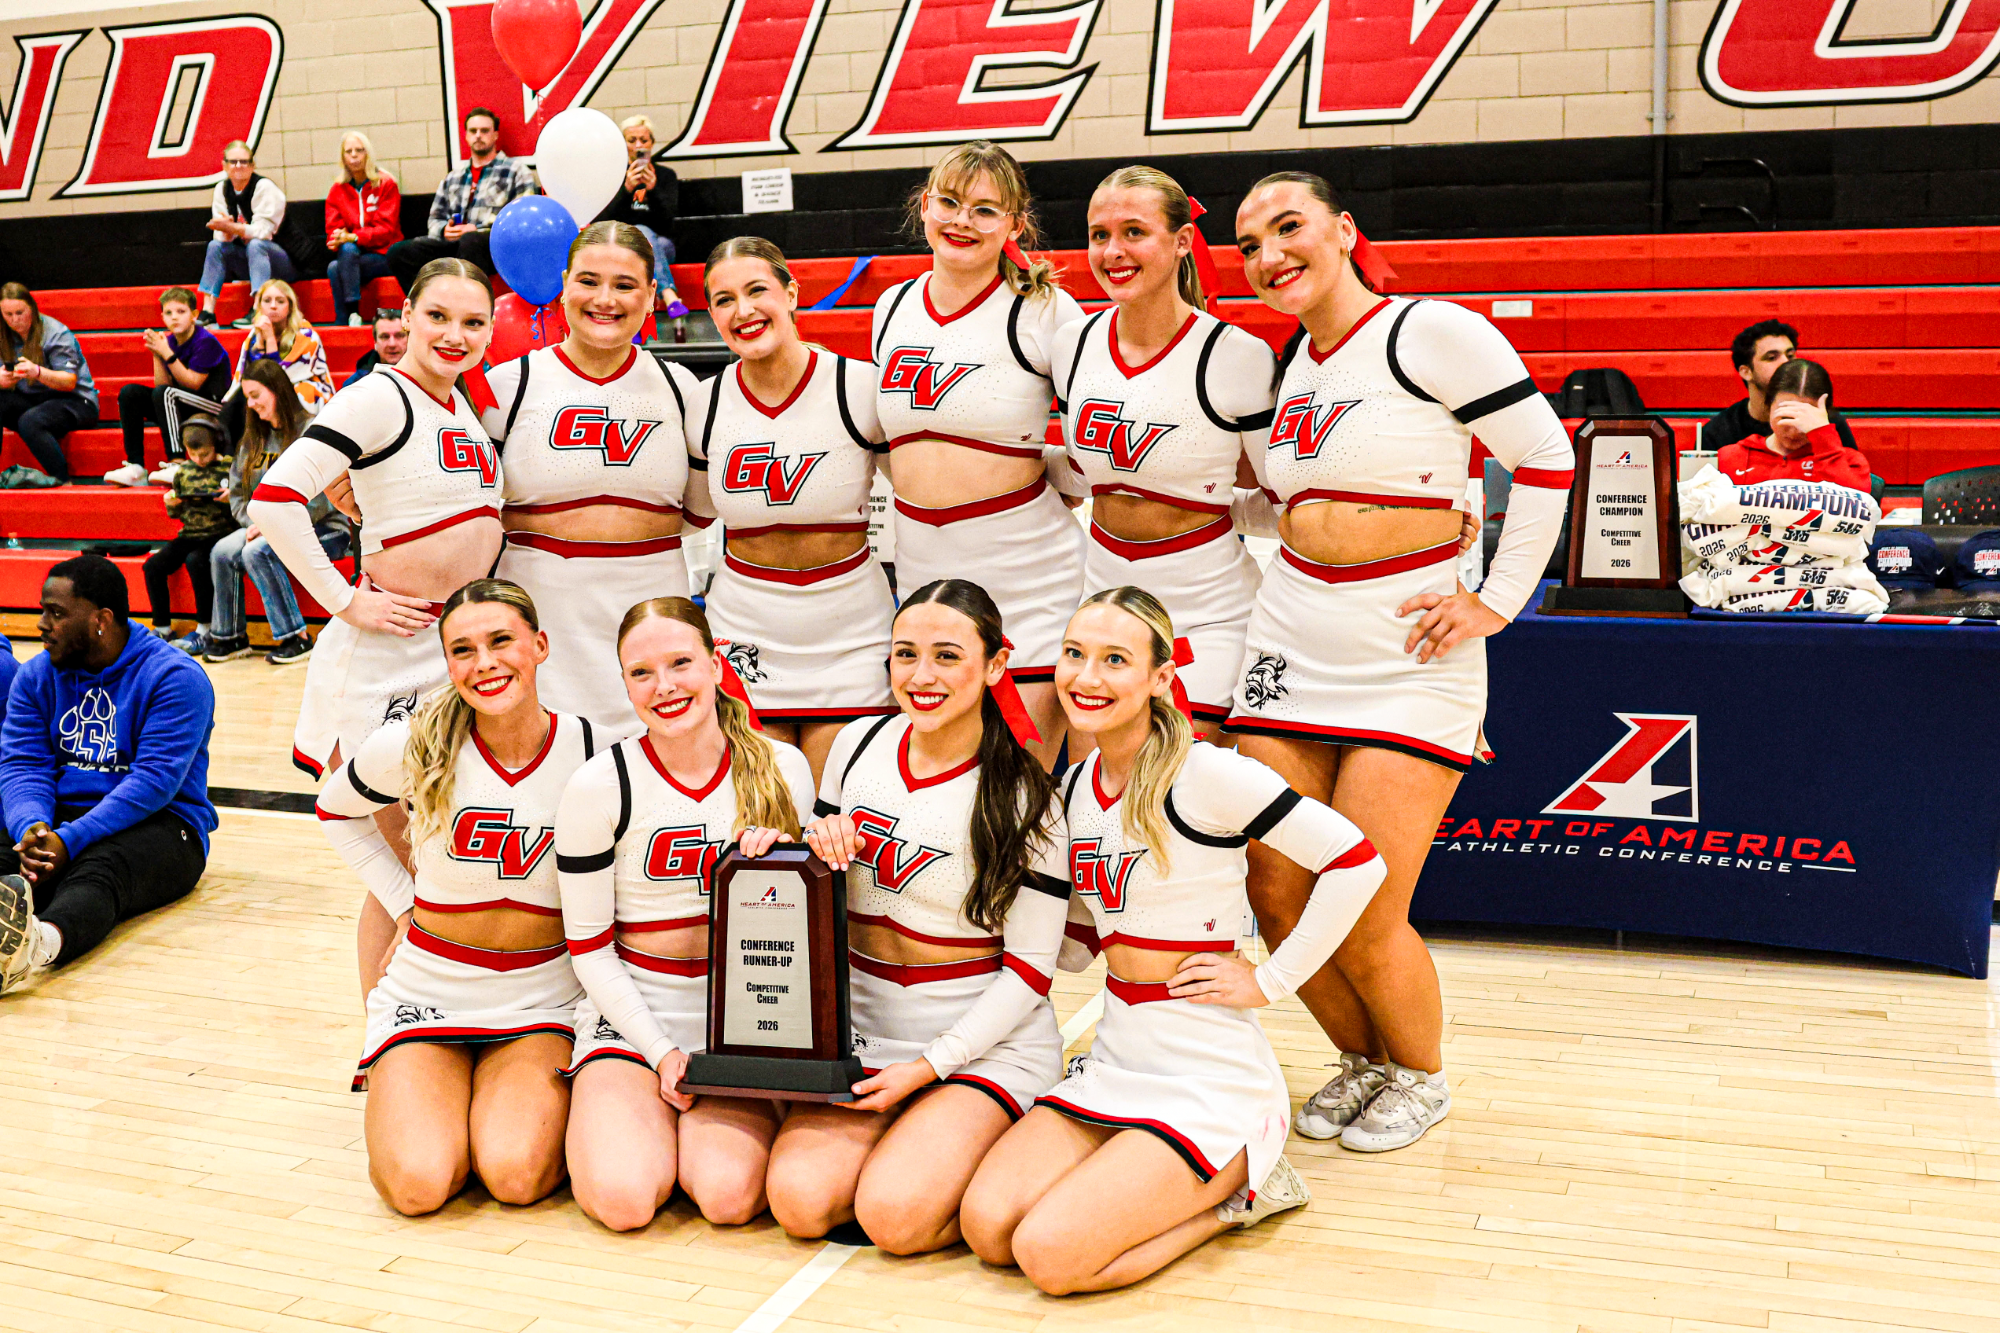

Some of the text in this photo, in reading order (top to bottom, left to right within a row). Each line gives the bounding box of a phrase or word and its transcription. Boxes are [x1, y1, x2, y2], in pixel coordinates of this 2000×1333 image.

[880, 346, 985, 411] GV
[1074, 398, 1180, 473] GV
[1267, 391, 1364, 461] GV
[549, 405, 664, 467] GV
[437, 427, 499, 488] GV
[722, 442, 829, 506] GV
[1596, 494, 1648, 504] CONFERENCE
[1739, 488, 1872, 522] CHAMPIONS
[1600, 507, 1643, 516] CHAMPION
[1741, 513, 1770, 525] 2026
[1601, 529, 1642, 538] COMPETITIVE
[1611, 538, 1631, 546] CHEER
[1699, 539, 1727, 558] 2026
[1611, 559, 1631, 568] 2026
[446, 806, 555, 880] GV
[1434, 817, 1856, 865] EART OF AMERICA
[1447, 841, 1793, 873] ATHLETIC CONFERENCE
[1069, 836, 1150, 913] GV
[741, 939, 795, 952] CONFERENCE
[743, 955, 793, 968] RUNNER-UP
[746, 981, 790, 994] COMPETITIVE
[757, 993, 778, 1005] CHEER
[757, 1020, 779, 1031] 2026
